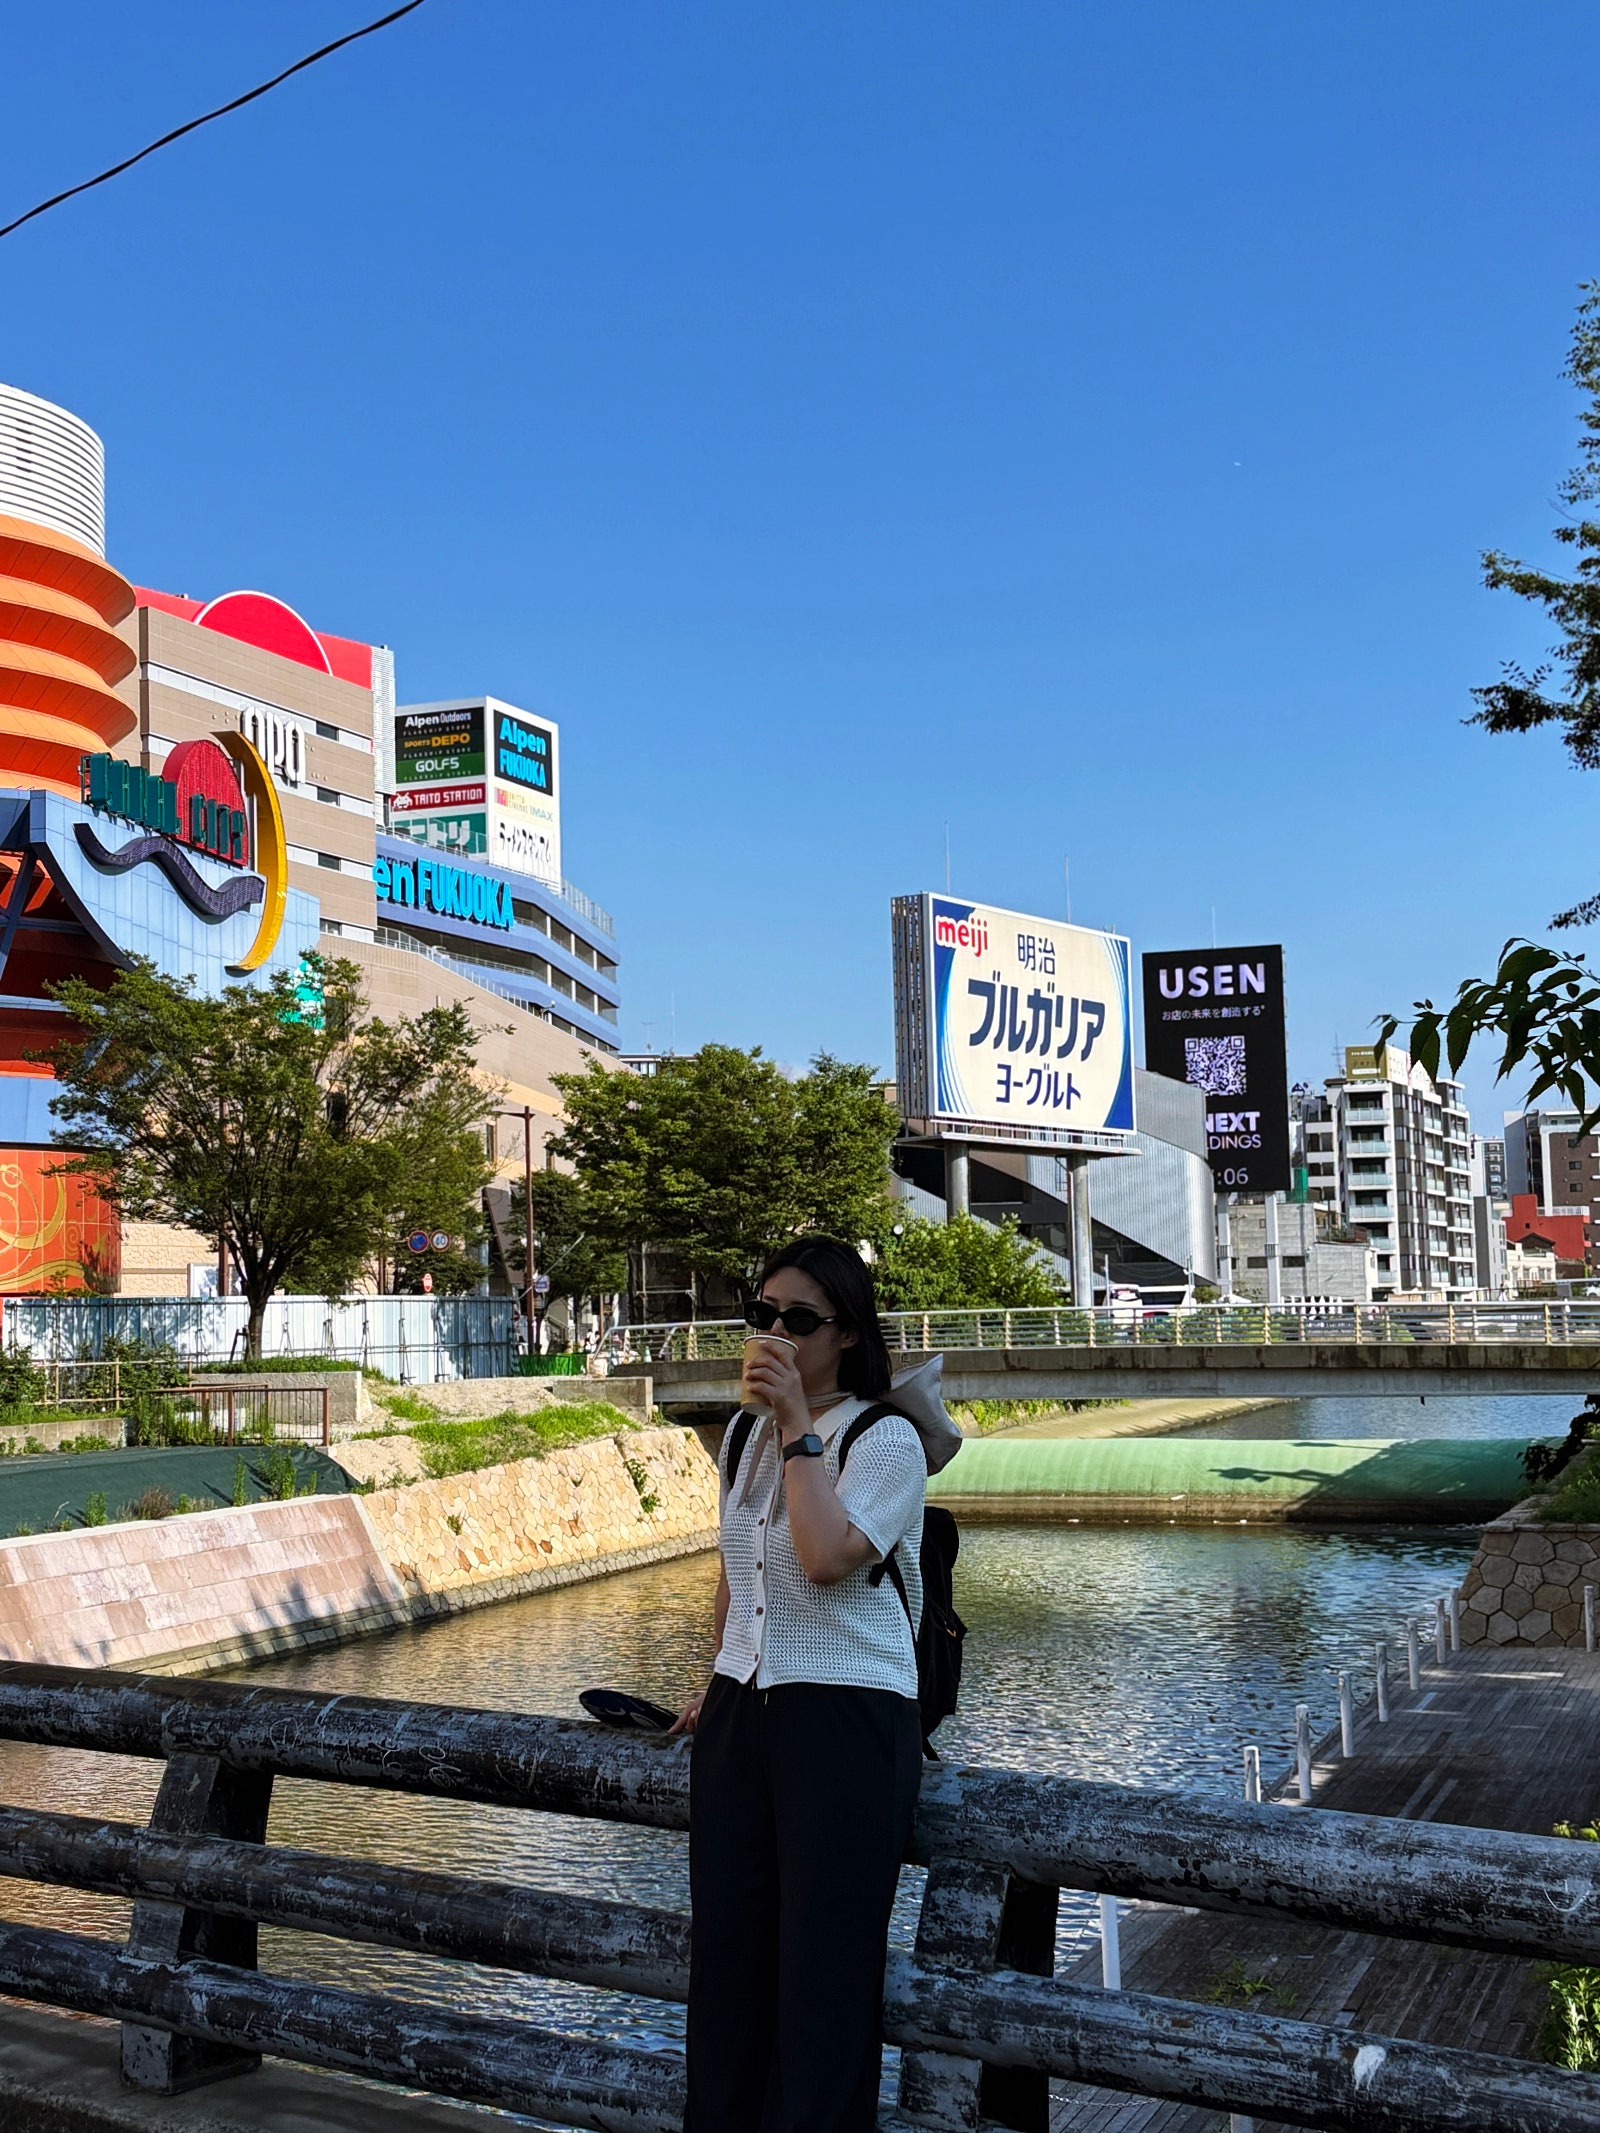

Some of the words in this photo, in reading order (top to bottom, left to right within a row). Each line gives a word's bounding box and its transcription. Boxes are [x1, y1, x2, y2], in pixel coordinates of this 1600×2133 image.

[404, 715, 439, 728] Alpen
[440, 712, 472, 723] Outdoors
[500, 717, 546, 756] Alpen
[404, 739, 431, 748] SPORTS
[431, 733, 470, 747] DEPO
[415, 757, 460, 773] GOLF5
[500, 748, 547, 788] FUKUOKA
[414, 793, 440, 806] TAITO
[443, 788, 482, 803] STATION
[418, 858, 514, 929] FUKUOKA
[937, 917, 989, 957] meiji
[1017, 933, 1055, 975] 明治
[1159, 963, 1265, 999] USEN
[968, 970, 1105, 1062] ブルガリア
[996, 1063, 1081, 1110] ヨーグルト
[1207, 1134, 1261, 1150] DINGS
[435, 1236, 446, 1246] 40
